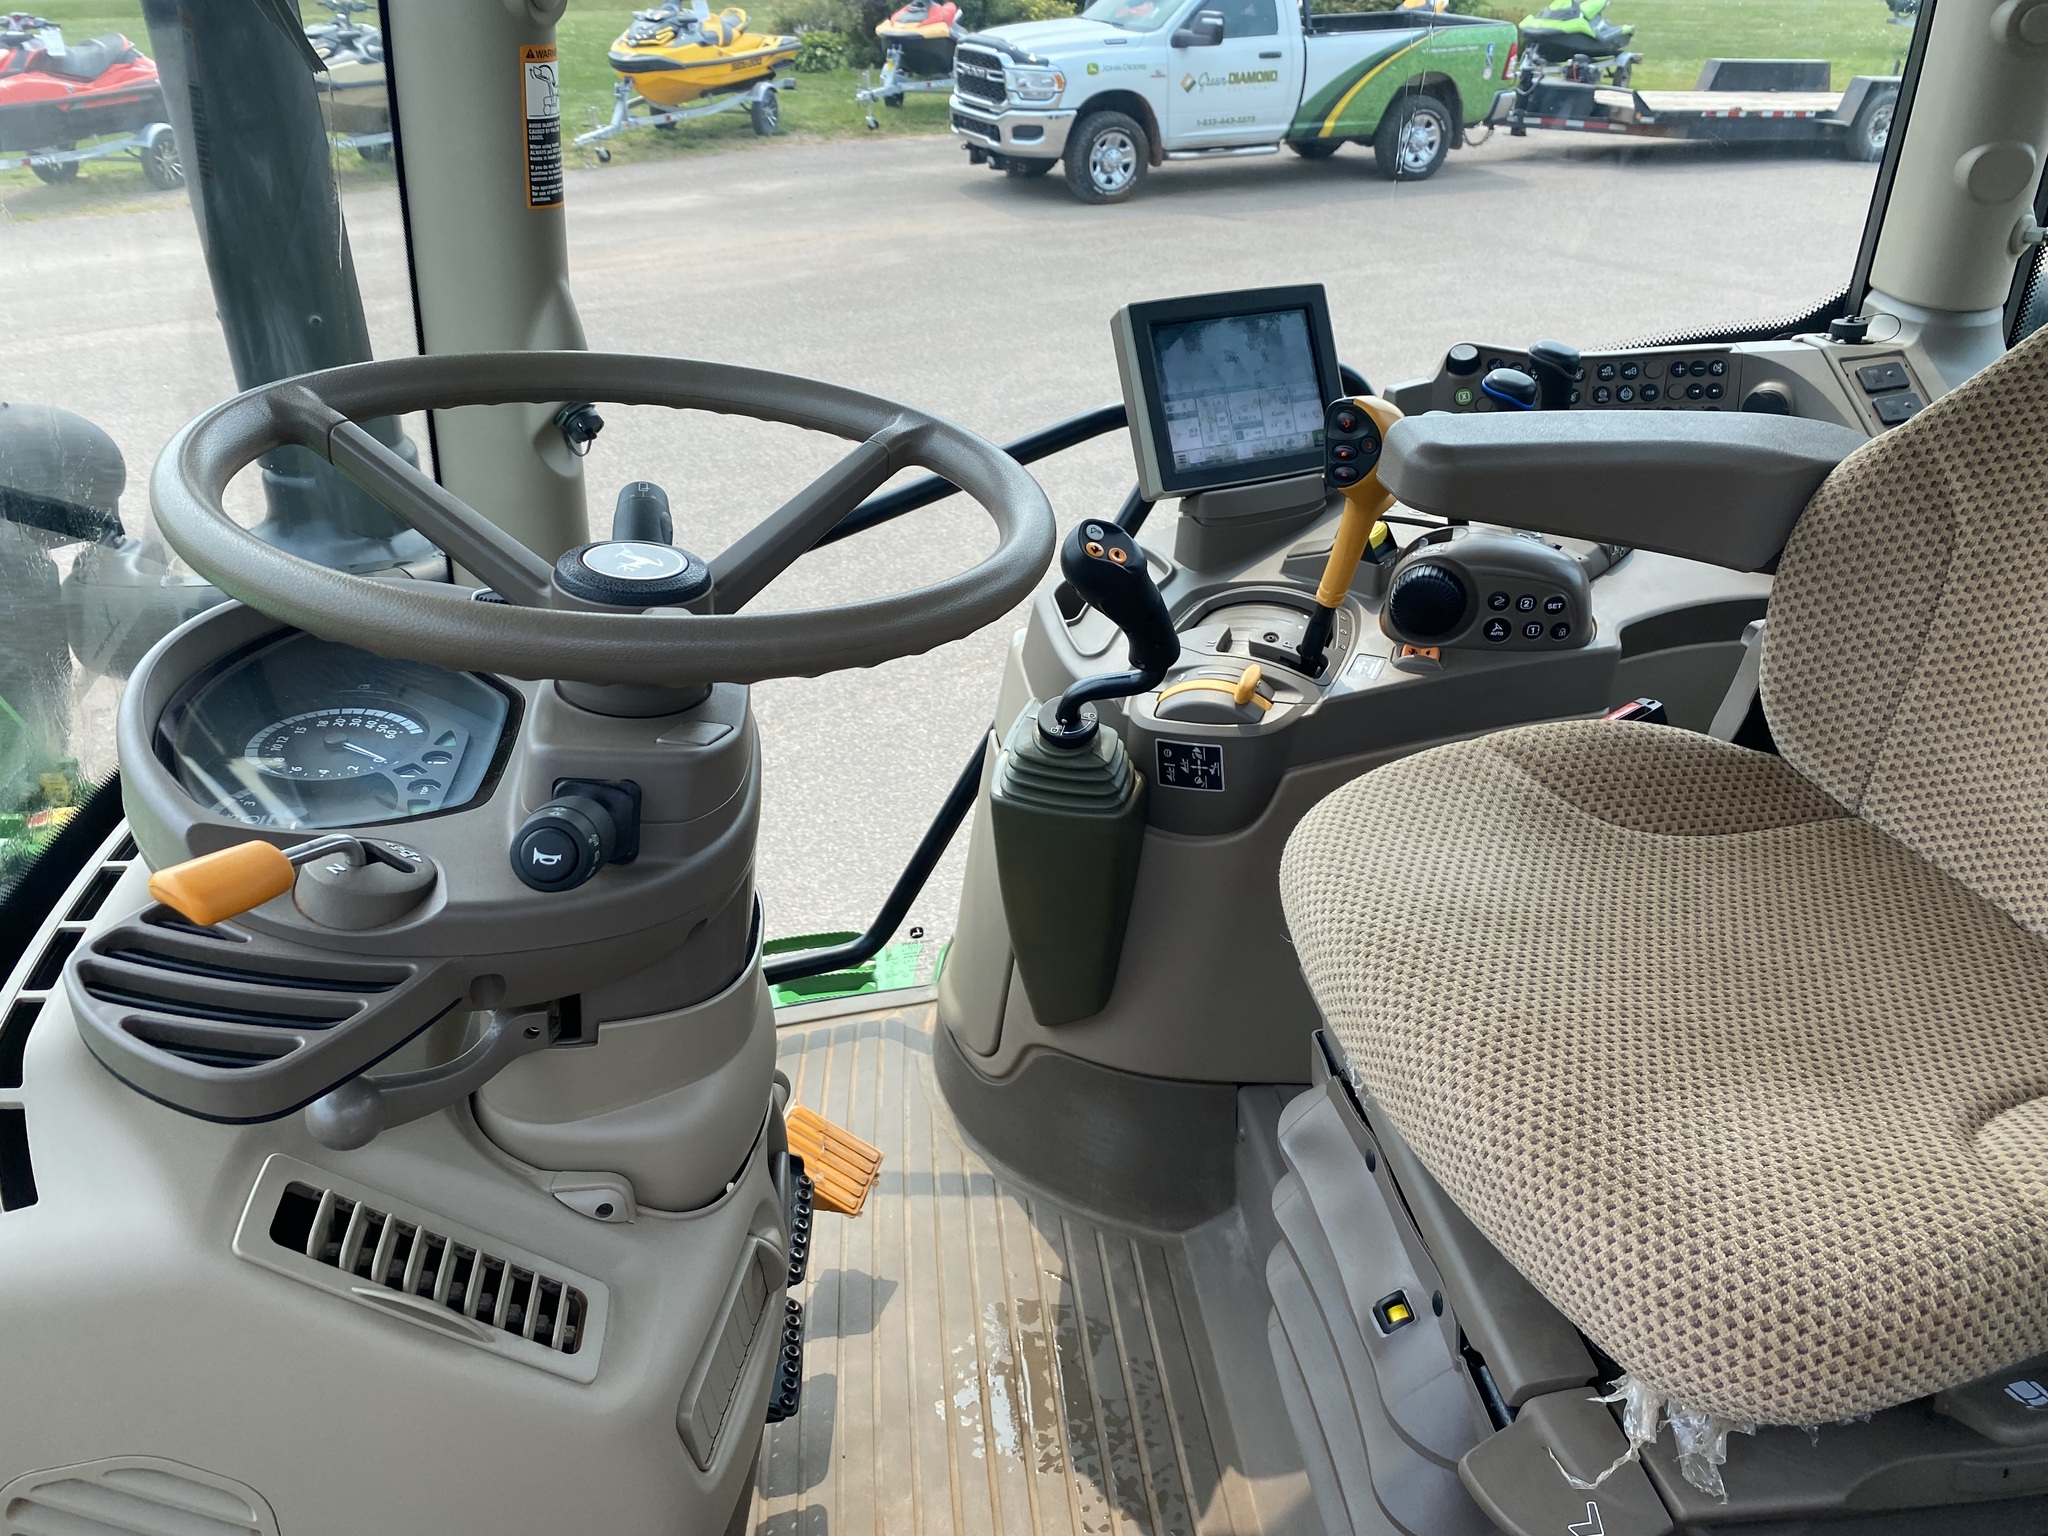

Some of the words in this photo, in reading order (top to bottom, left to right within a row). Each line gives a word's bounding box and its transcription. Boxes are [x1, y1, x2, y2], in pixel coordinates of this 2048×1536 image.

[1198, 72, 1227, 92] Green
[1228, 70, 1278, 84] DIAMOND
[333, 718, 346, 727] 20
[349, 718, 362, 727] 30
[365, 720, 377, 730] 40
[295, 727, 307, 735] 15
[376, 724, 389, 733] 50
[385, 730, 397, 739] 60
[278, 735, 290, 744] 12
[270, 743, 283, 752] 10
[326, 863, 346, 875] N
